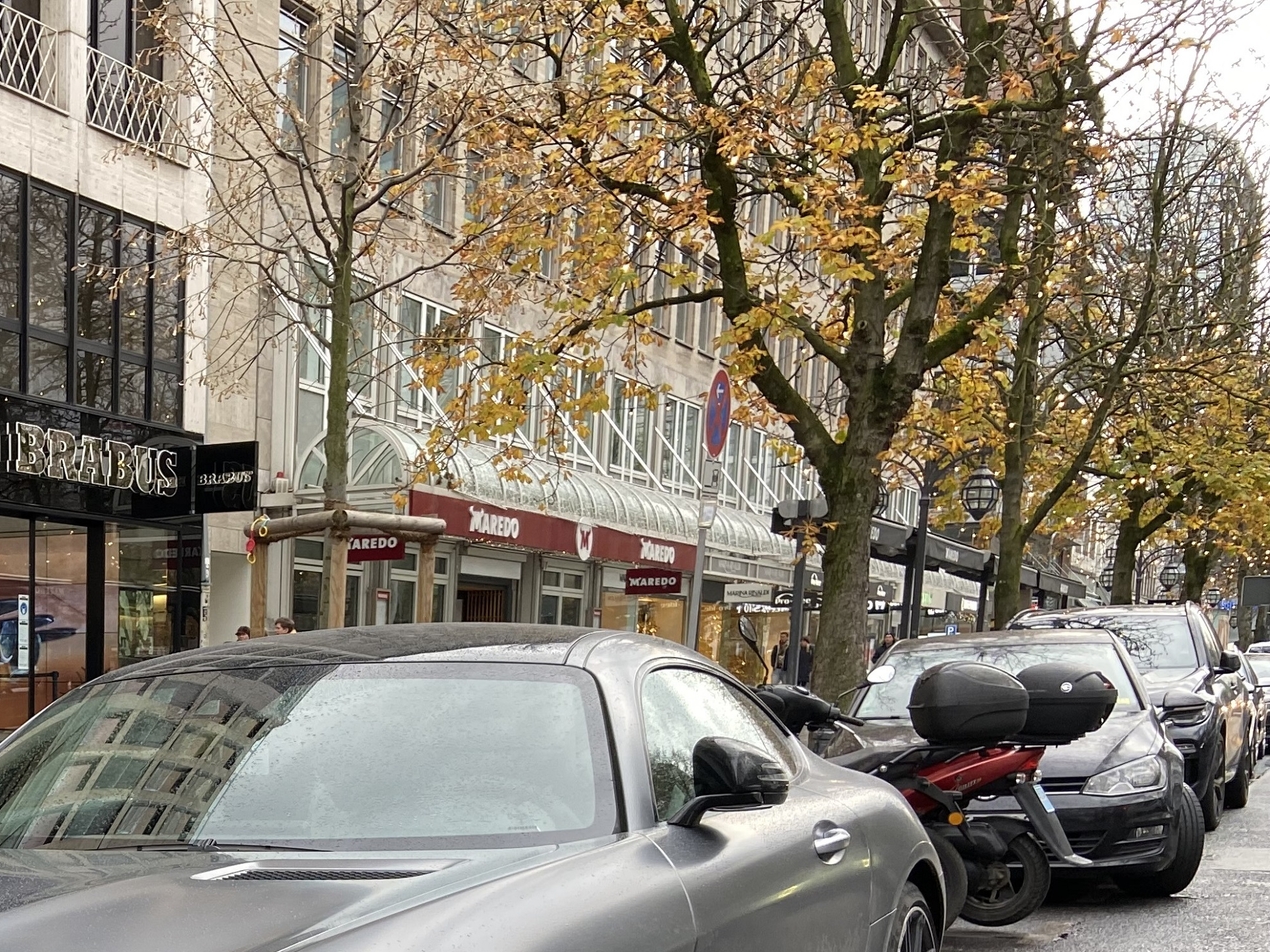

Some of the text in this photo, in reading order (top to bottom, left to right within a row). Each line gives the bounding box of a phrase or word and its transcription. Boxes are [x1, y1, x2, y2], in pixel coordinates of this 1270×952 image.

[14, 421, 179, 498] BRABUS
[196, 470, 255, 486] BRABUS
[468, 505, 520, 539] MAREDO
[640, 538, 676, 564] MAREDO
[629, 576, 677, 587] MAREDO
